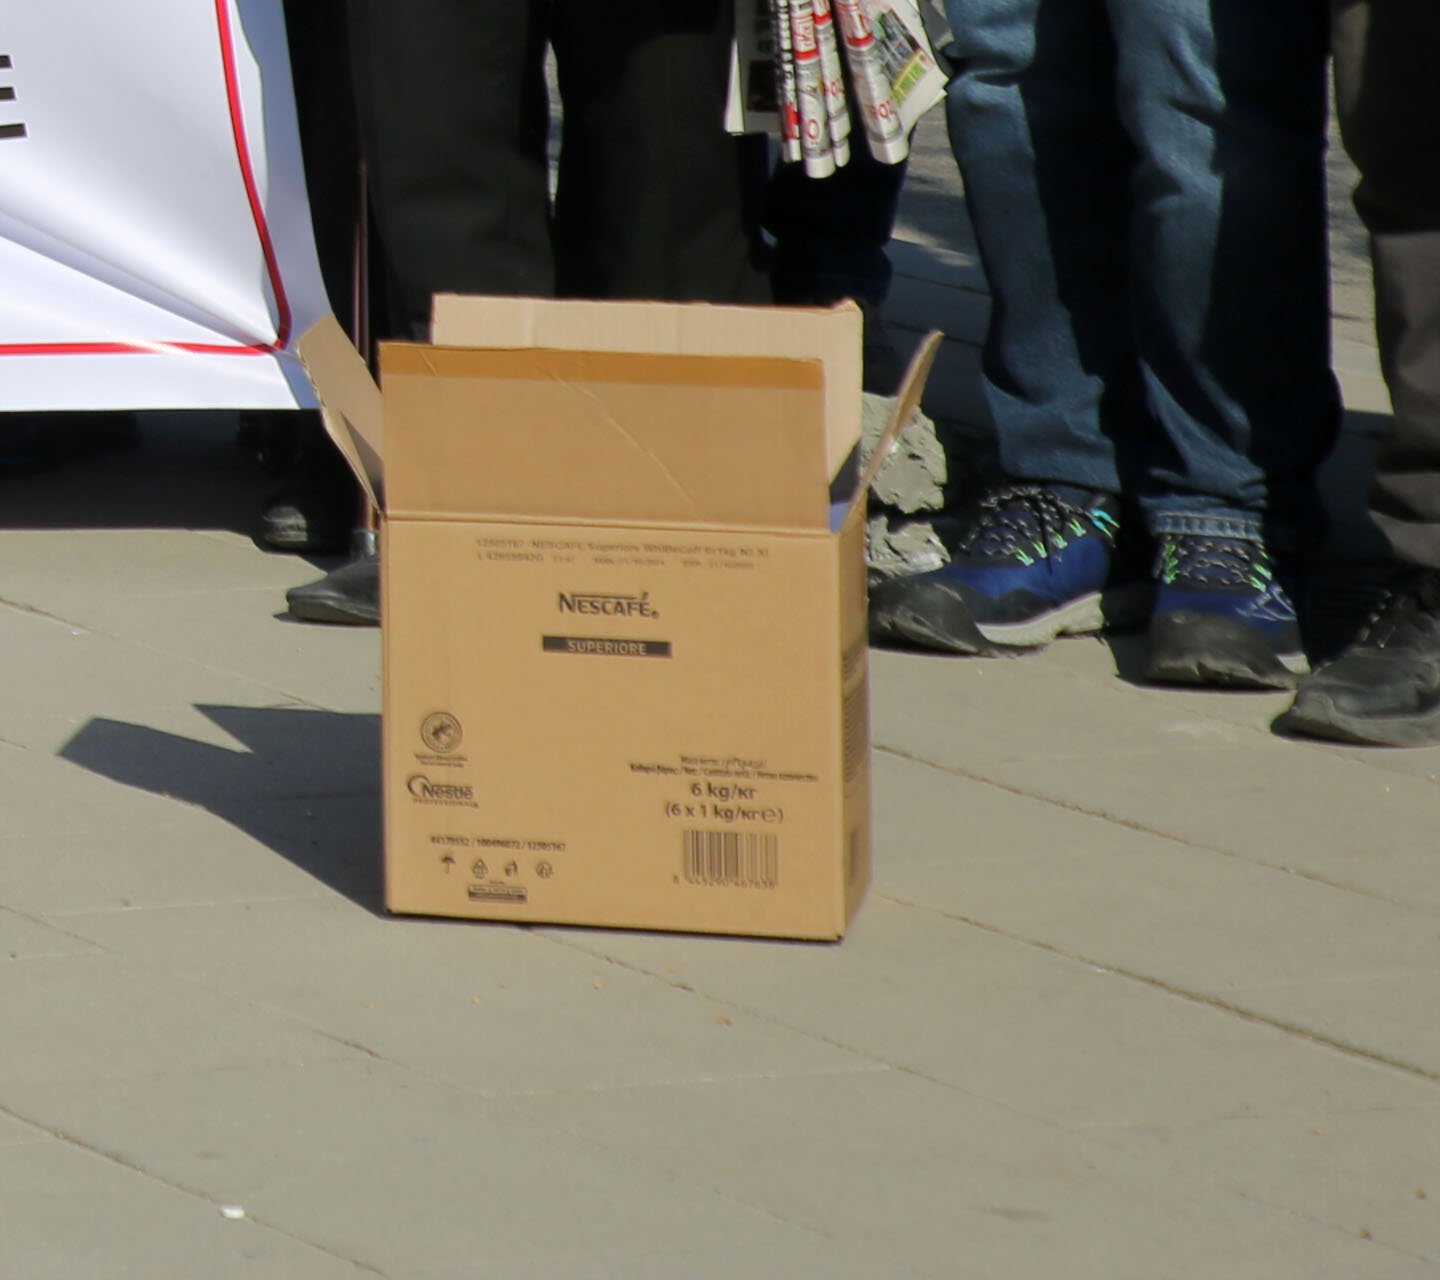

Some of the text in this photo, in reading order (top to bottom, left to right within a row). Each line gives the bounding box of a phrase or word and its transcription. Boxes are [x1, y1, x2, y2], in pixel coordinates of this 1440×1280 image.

[558, 590, 652, 618] NESCAFÉ
[567, 640, 647, 656] SUPERIORE
[691, 782, 702, 797] 6
